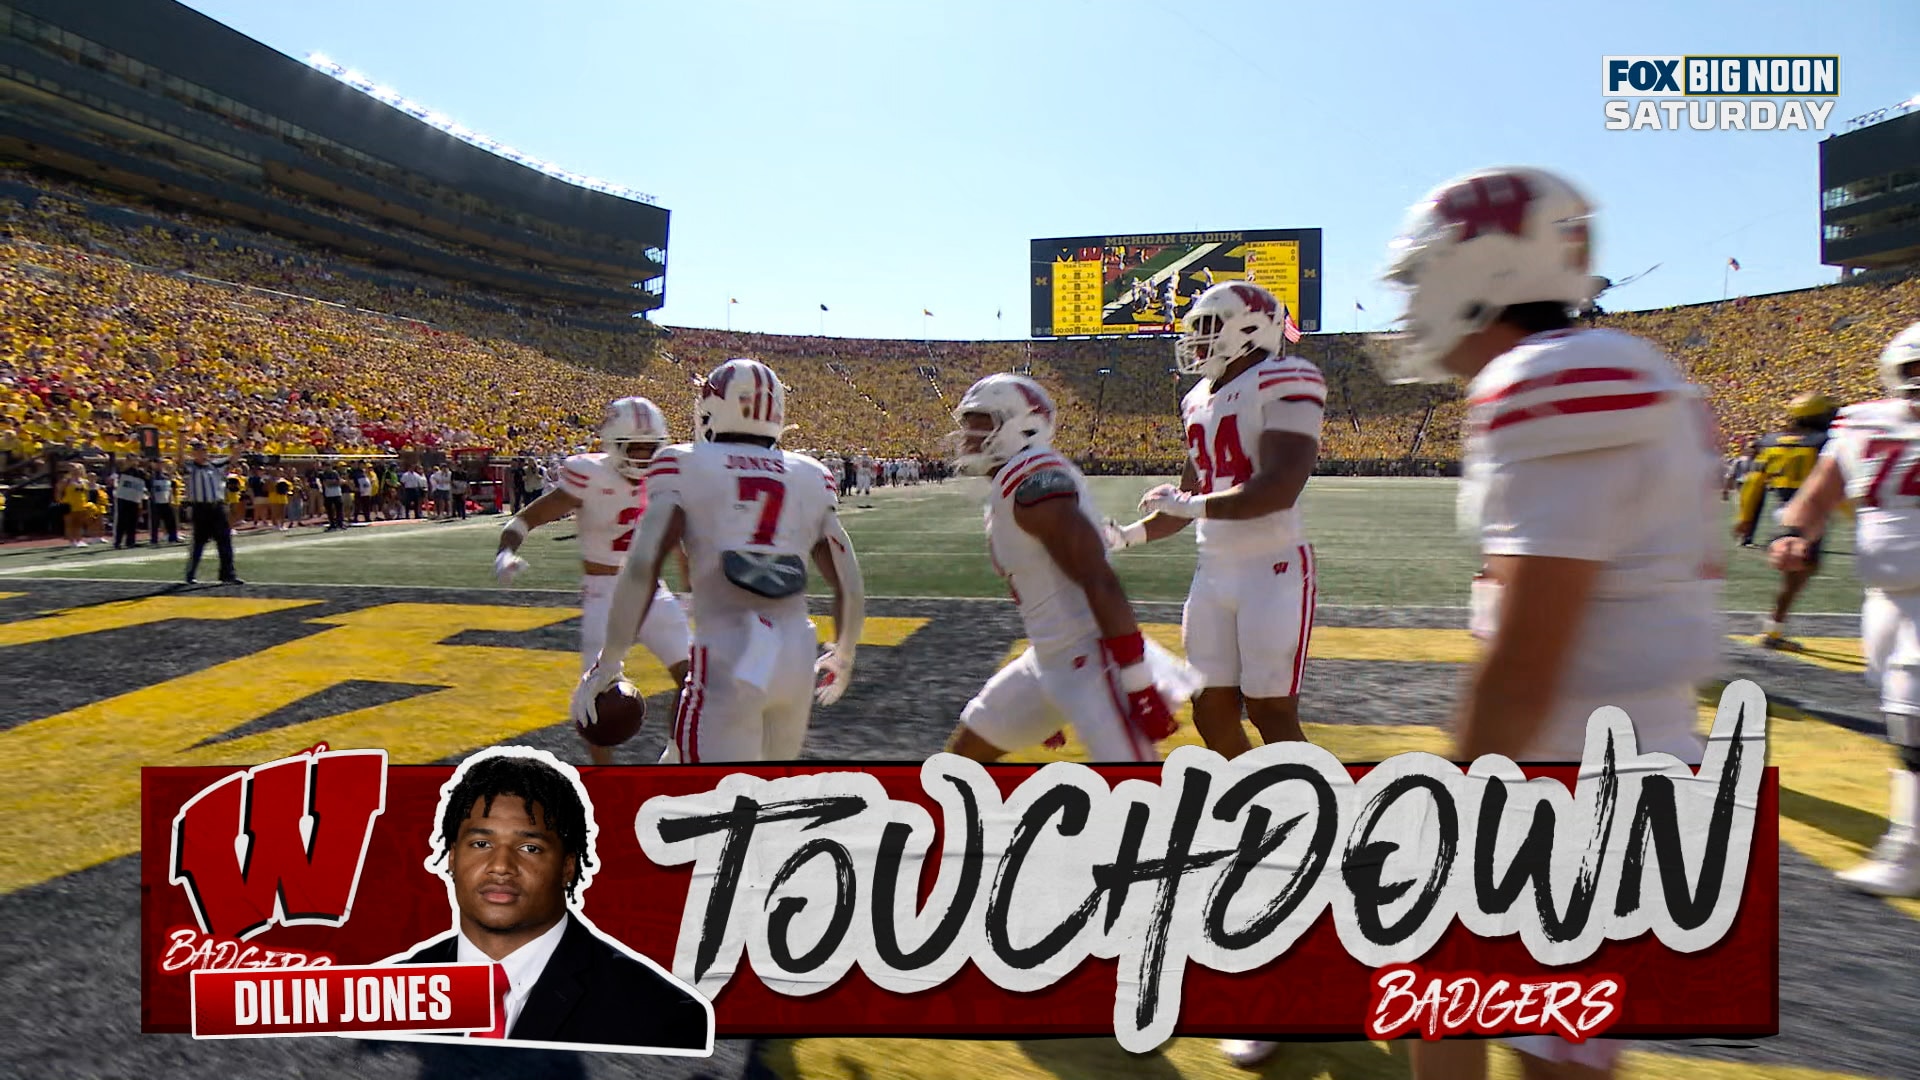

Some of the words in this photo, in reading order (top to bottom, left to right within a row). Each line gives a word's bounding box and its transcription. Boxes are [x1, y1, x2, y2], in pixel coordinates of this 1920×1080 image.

[1105, 235, 1176, 246] MICHIGAN
[1180, 232, 1243, 243] STADIUM
[726, 454, 785, 474] JONES
[738, 476, 786, 546] 7
